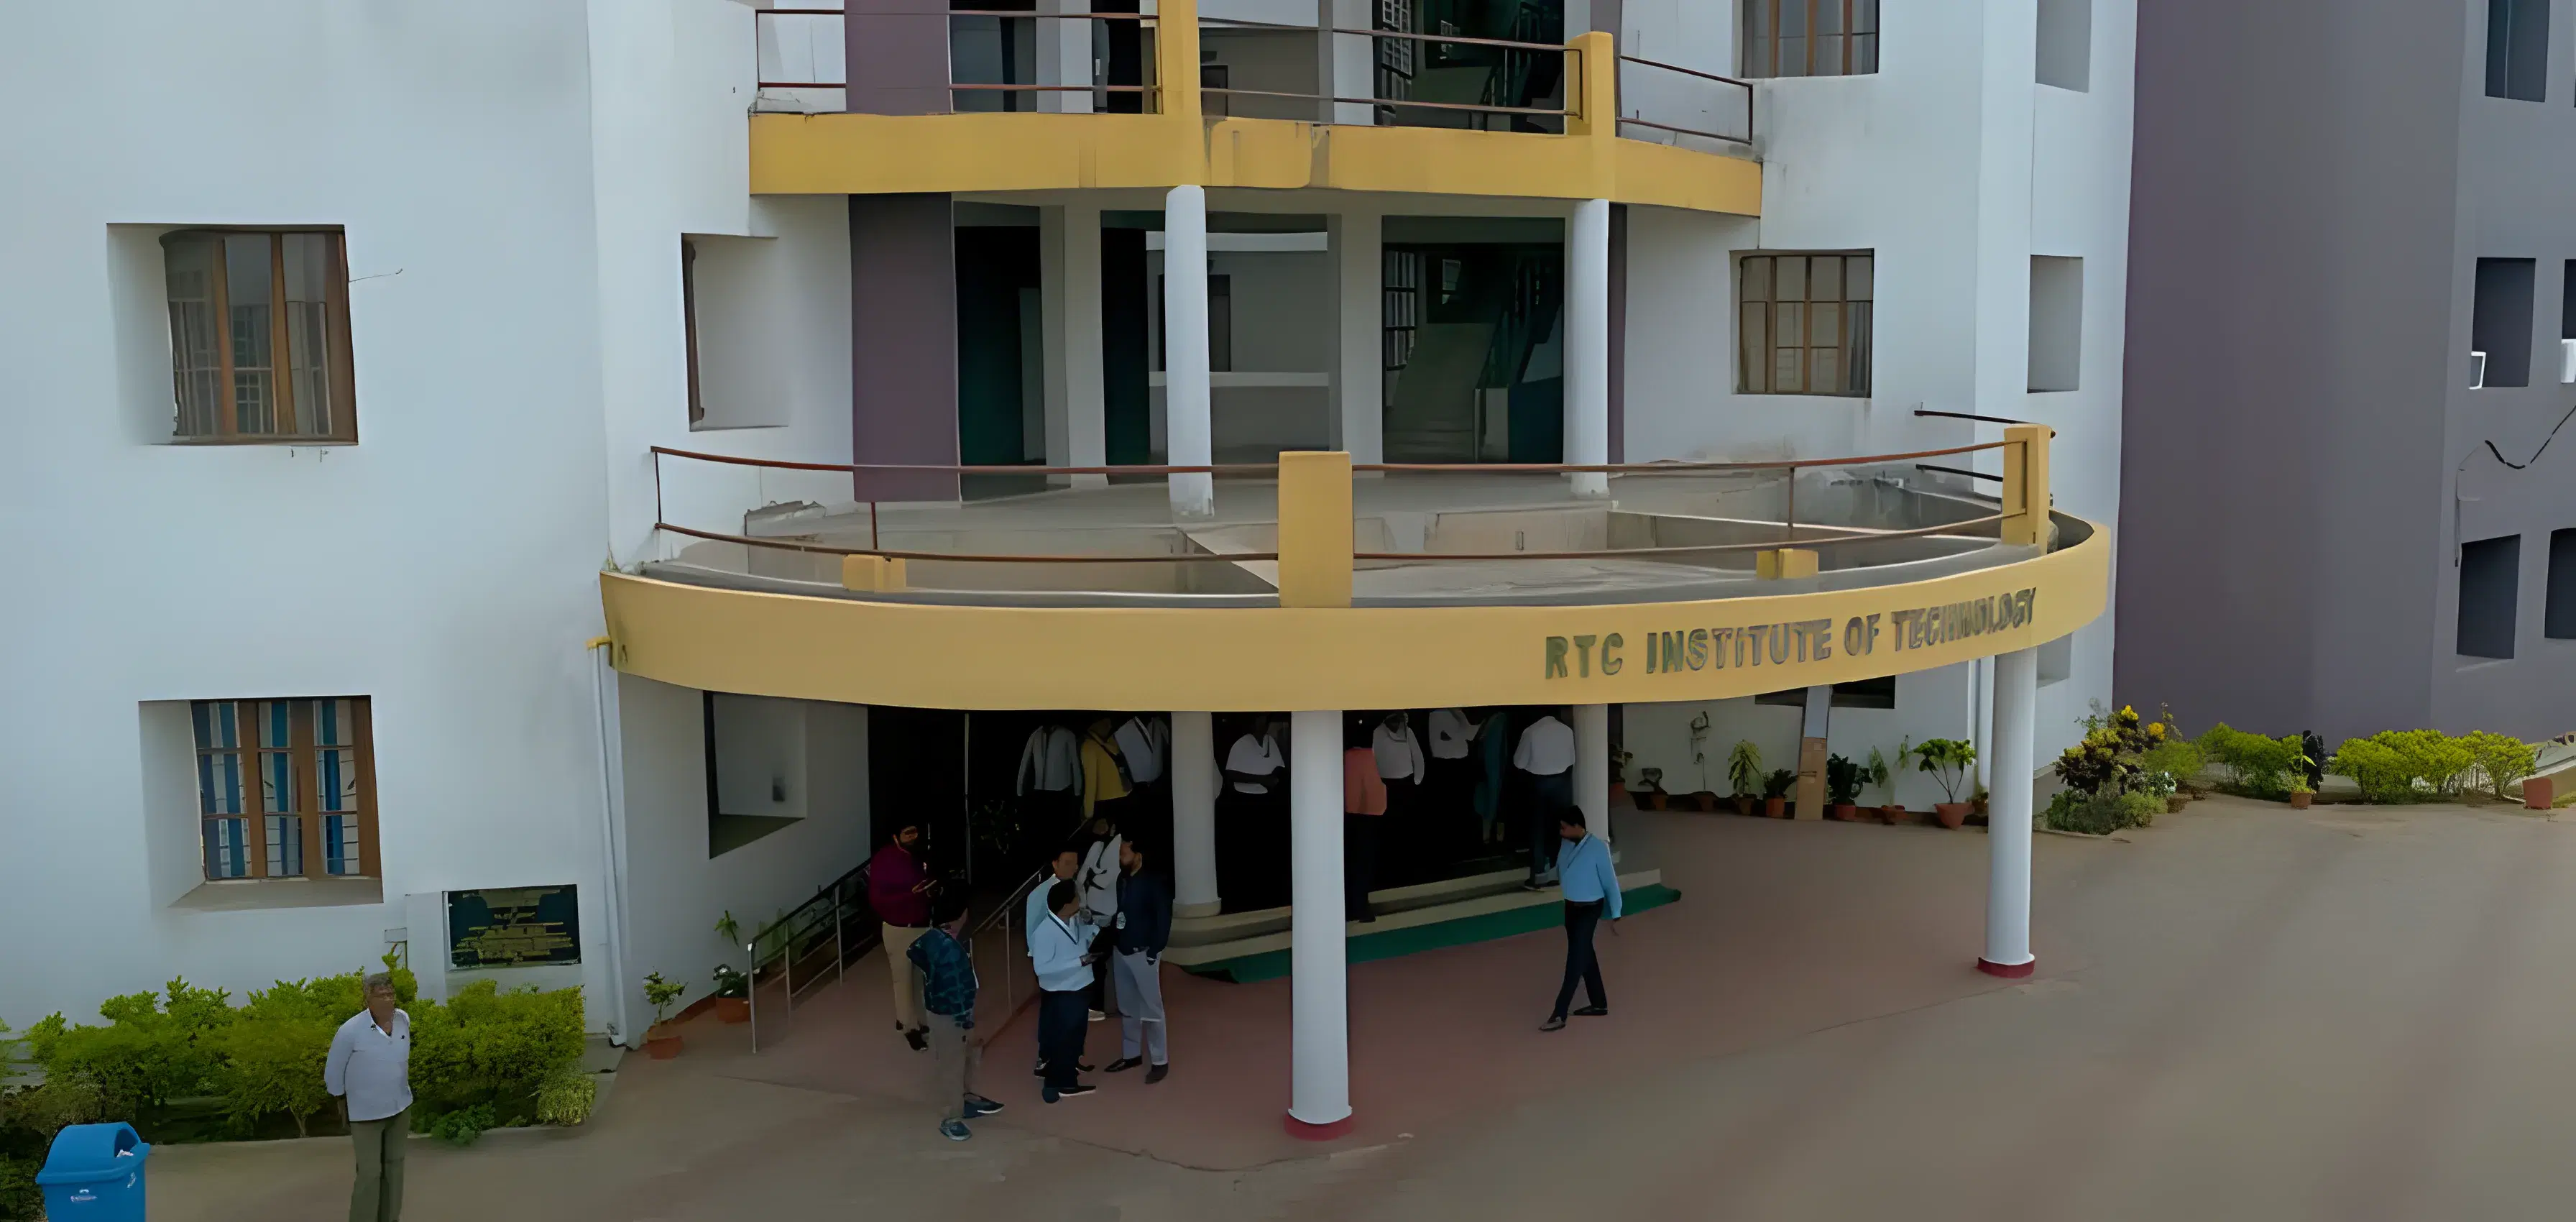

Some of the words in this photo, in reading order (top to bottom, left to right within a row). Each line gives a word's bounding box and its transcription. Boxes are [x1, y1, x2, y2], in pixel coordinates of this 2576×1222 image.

[1545, 633, 1624, 679] RTC
[1647, 618, 1832, 674] INSTITUTE
[1844, 612, 1881, 656] OF
[1891, 587, 2037, 652] TECHNOLOGY
